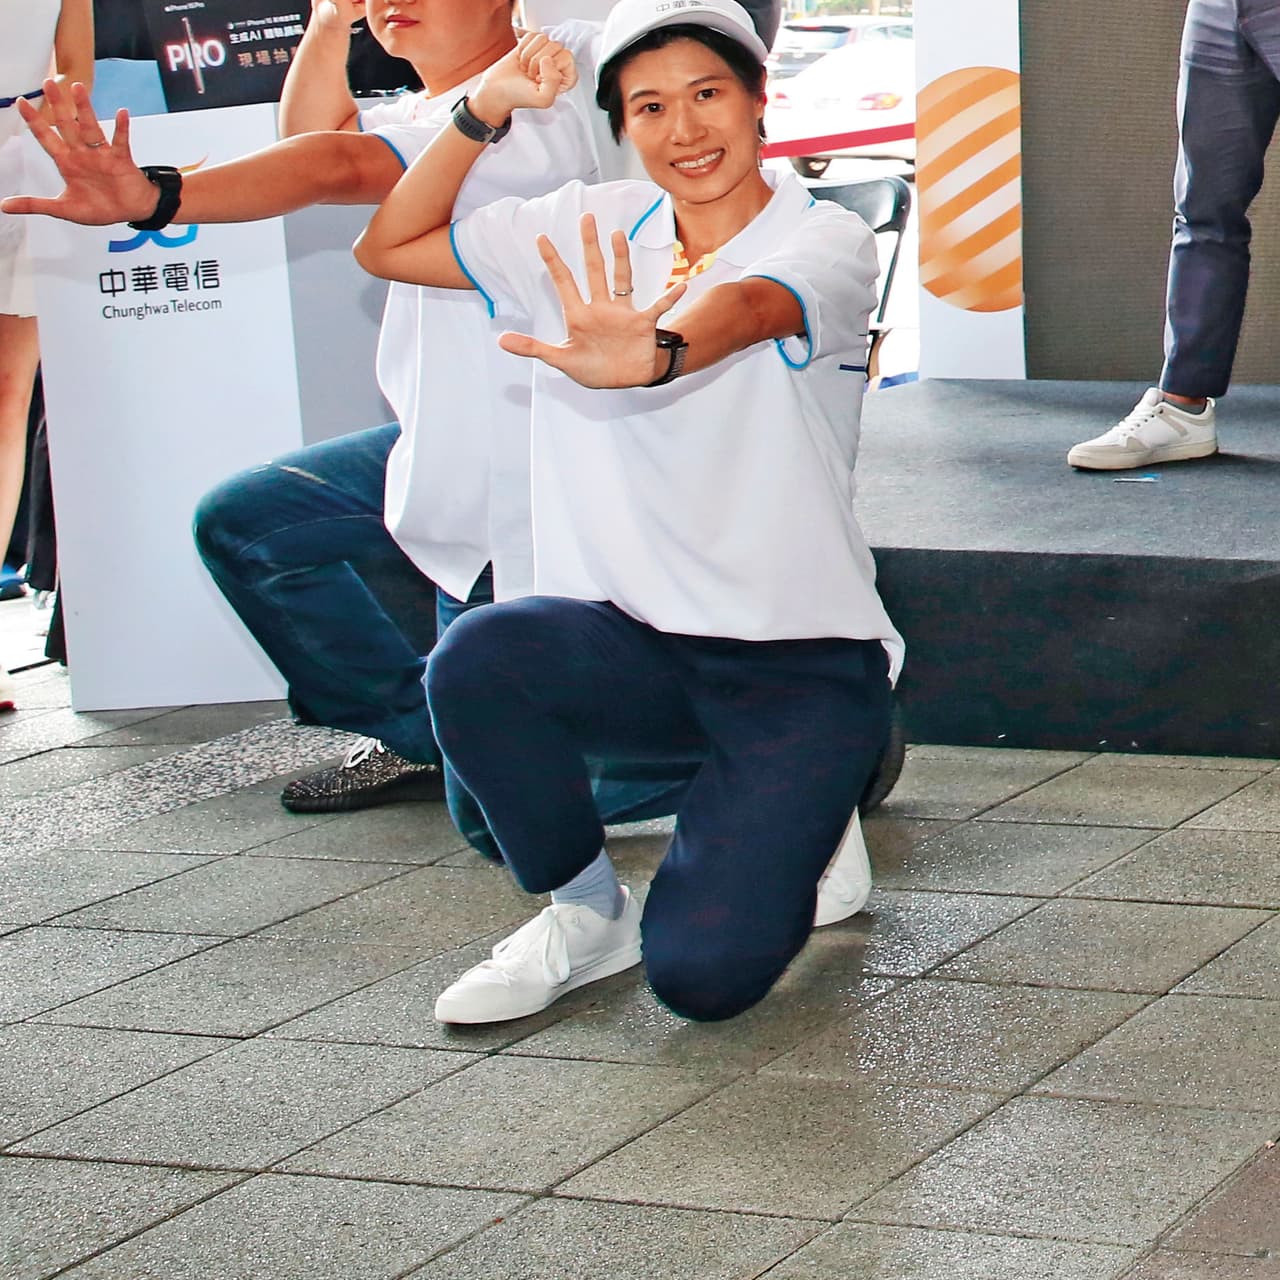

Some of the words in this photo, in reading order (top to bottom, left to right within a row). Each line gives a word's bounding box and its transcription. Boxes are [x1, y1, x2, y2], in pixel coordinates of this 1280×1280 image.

[237, 47, 298, 68] 現場抽
[98, 259, 220, 298] 中華電信
[102, 303, 169, 320] Chunghwa
[170, 299, 223, 314] Telecom
